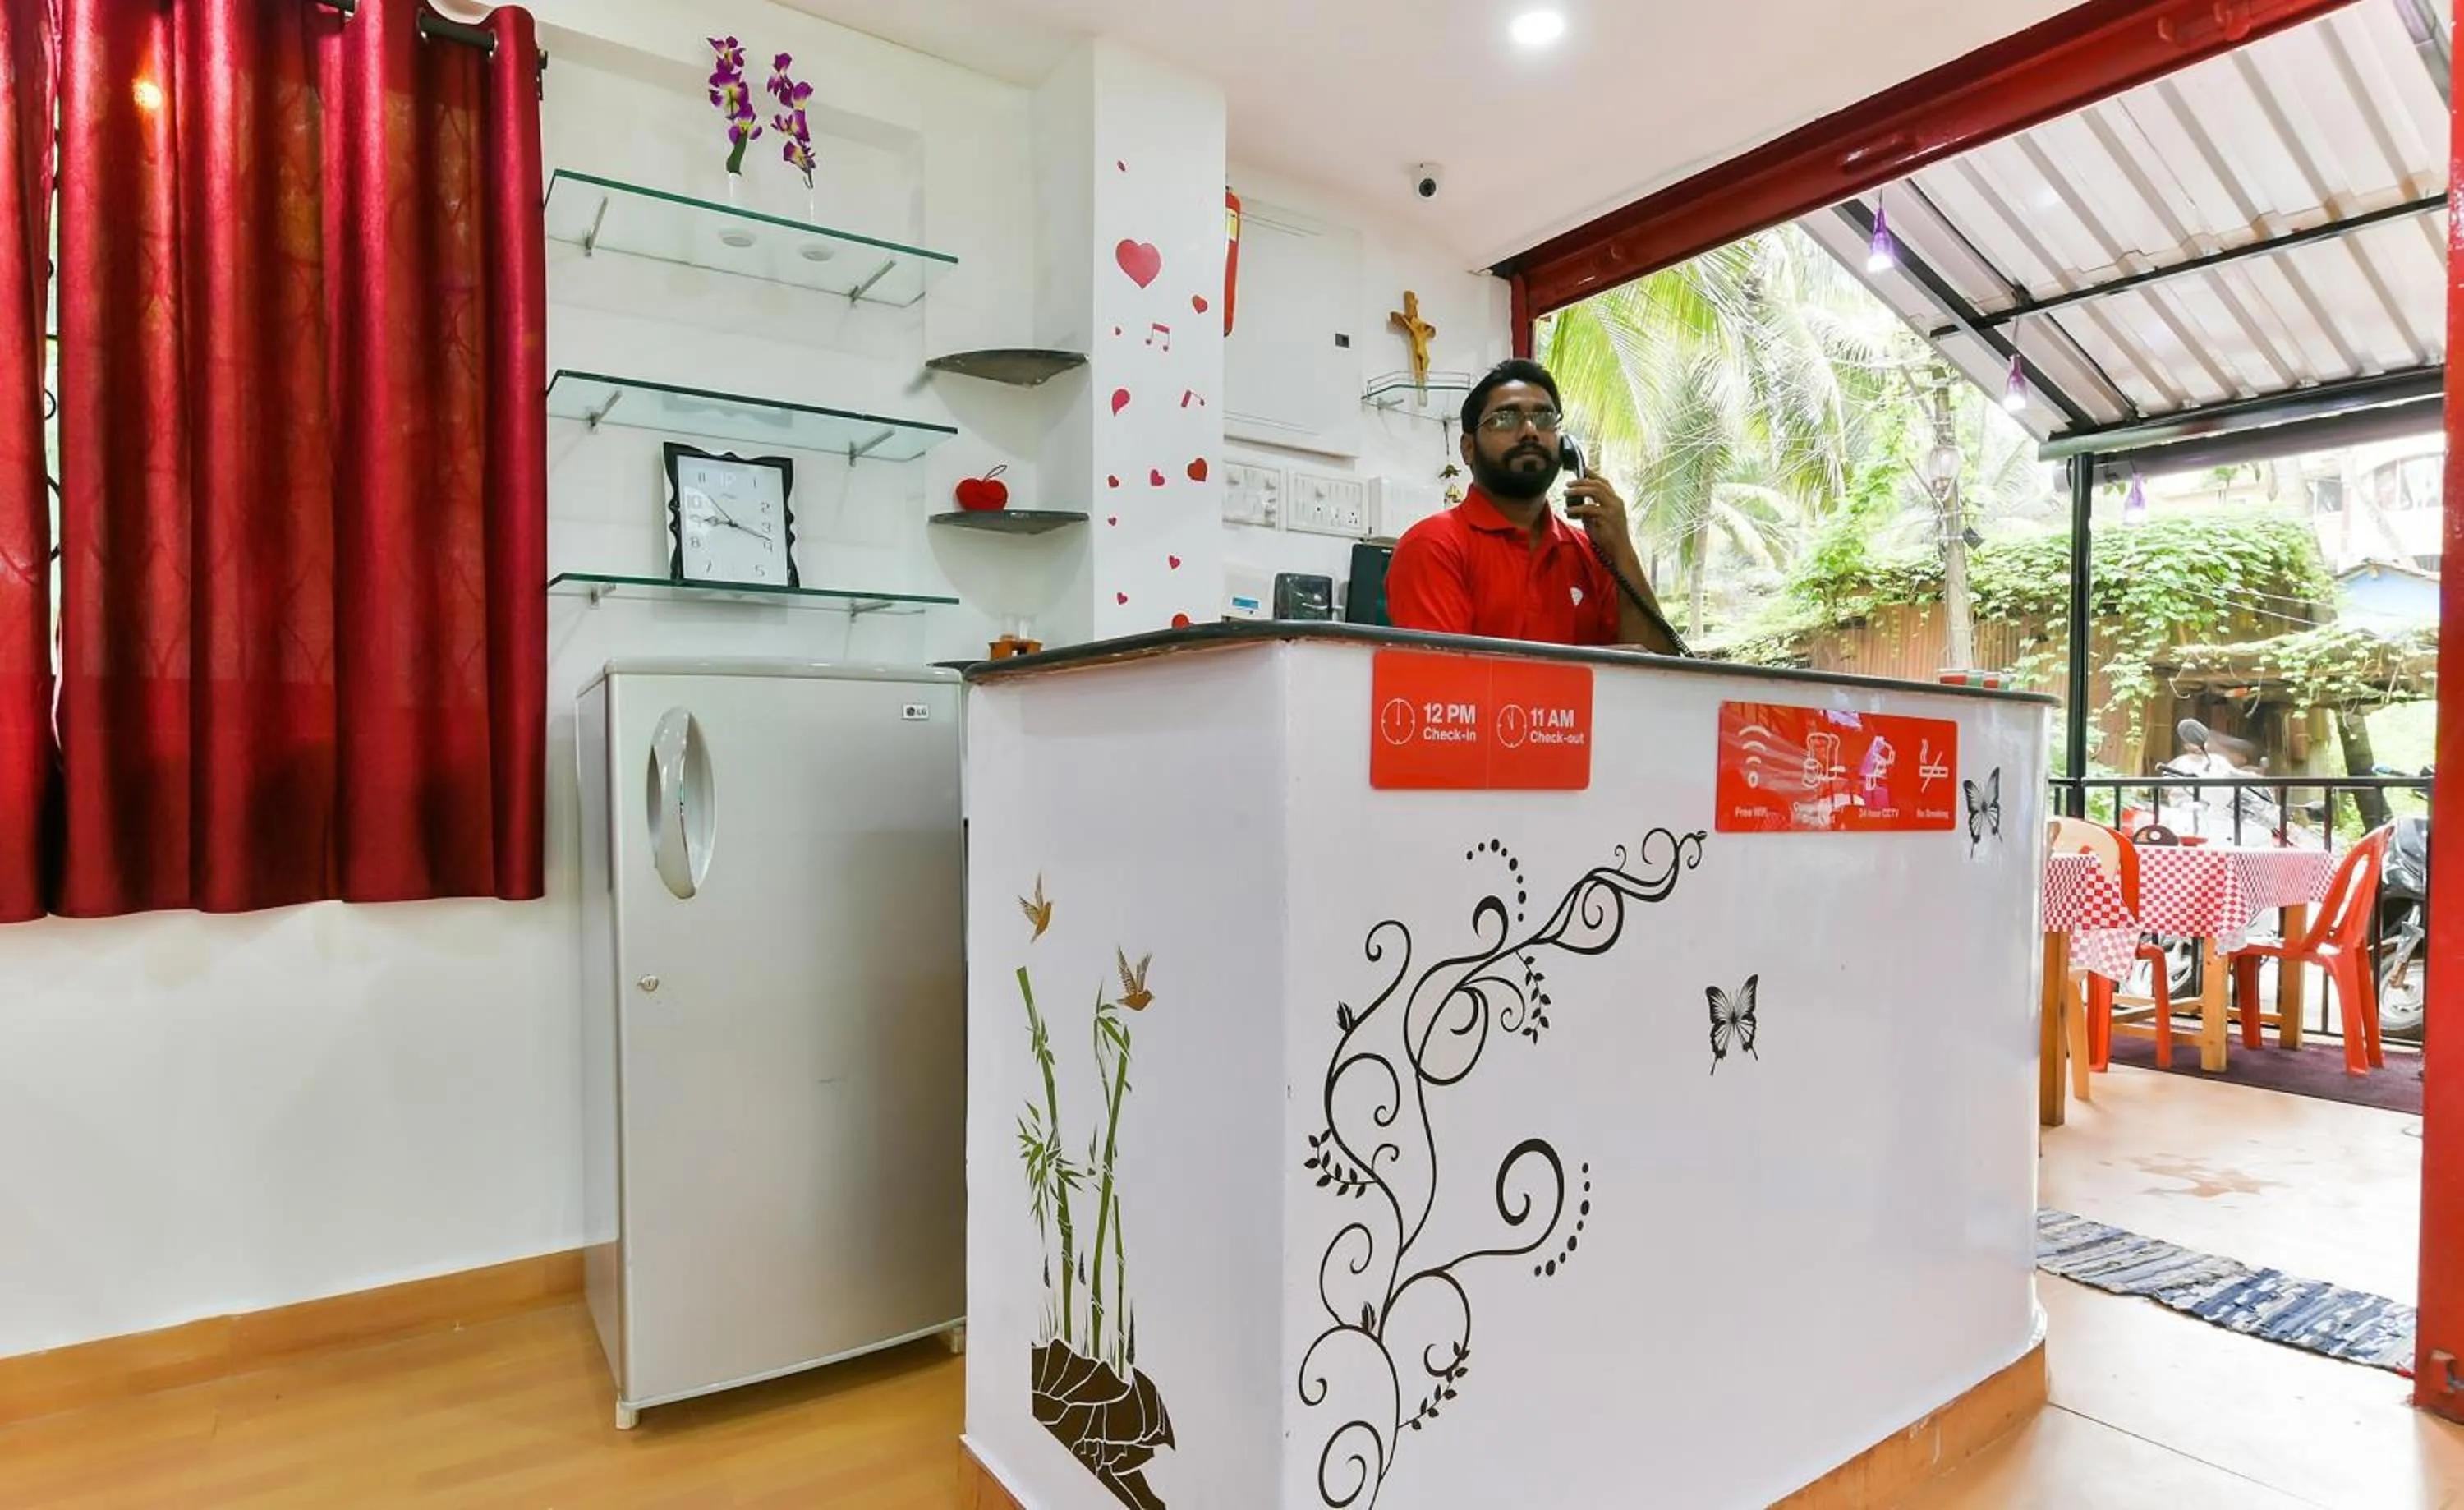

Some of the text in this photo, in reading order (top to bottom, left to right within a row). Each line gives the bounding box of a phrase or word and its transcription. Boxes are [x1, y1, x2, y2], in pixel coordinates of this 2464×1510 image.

[1423, 702, 1477, 725] 12 PM
[1530, 709, 1575, 728] 11 AM
[1423, 726, 1477, 742] Check-in
[1529, 730, 1585, 745] Check-out
[1882, 807, 1901, 819] CCTV
